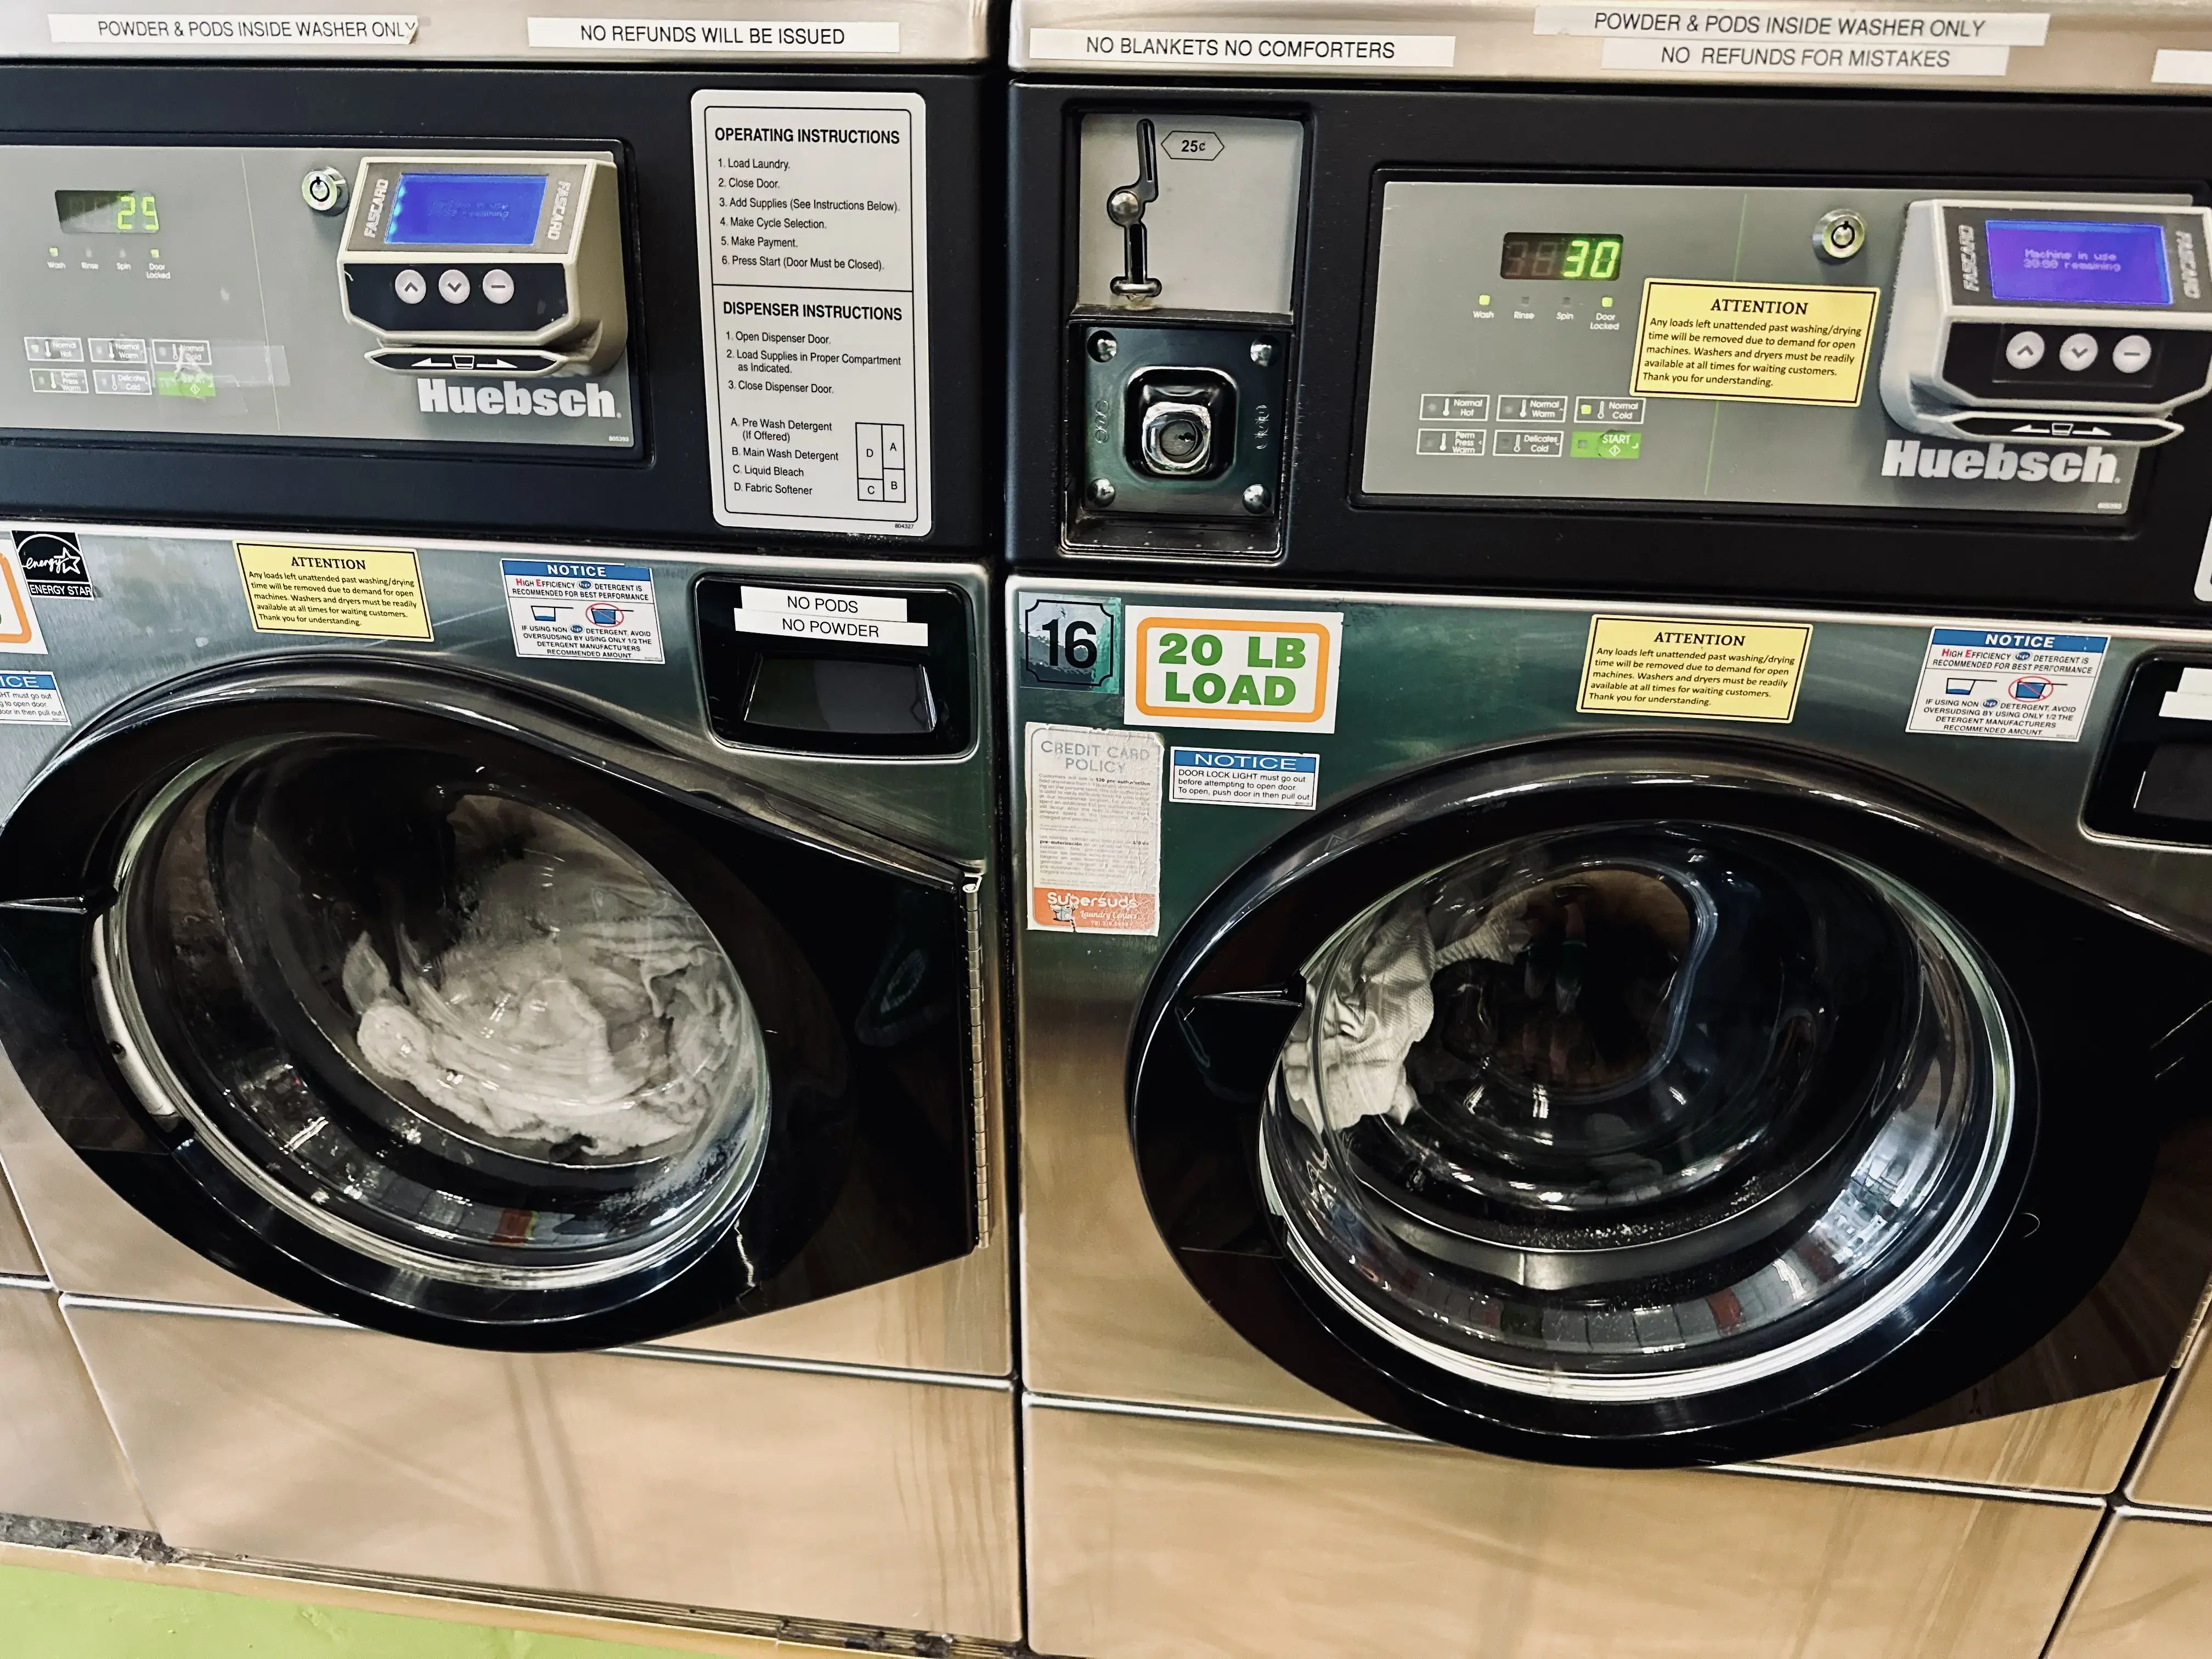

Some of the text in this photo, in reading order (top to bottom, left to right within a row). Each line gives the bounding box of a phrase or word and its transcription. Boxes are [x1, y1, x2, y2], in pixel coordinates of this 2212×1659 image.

[98, 21, 415, 37] POWDER & PODS INSIDE WASHER ONLY
[1595, 13, 1986, 37] POWDER & PODS INSIDE WASHER ONLY
[581, 25, 844, 44] NO REFUNDS WILL BE ISSUED
[1087, 37, 1394, 58] NO BLANKETS NO COMFORTERS
[1662, 47, 1950, 67] NO REFUNDS FOR MISTAKES
[715, 127, 899, 144] OPERATING INSTRUCTIONS
[1182, 140, 1205, 152] 25¢
[718, 158, 790, 171] 1. Load Laundry.
[719, 178, 780, 188] 2. Close Door.
[117, 196, 159, 229] 25
[720, 198, 900, 213] 3. Add Supplies (See Instructions Below).
[720, 217, 827, 229] 4. Make Cycle Selection.
[721, 236, 798, 249] 5. Make Payment.
[722, 256, 884, 272] 6. Press Start (Door Must be Closed).
[1564, 240, 1620, 278] 30
[724, 302, 902, 320] DISPENSER INSTRUCTIONS
[1711, 299, 1808, 314] ATTENTION
[1556, 312, 1573, 320] Spin
[1596, 313, 1615, 321] Door
[1650, 318, 1861, 337] Any loads left unattended past washing/drying
[1649, 331, 1668, 340] time
[1672, 332, 1686, 341] will
[1689, 333, 1700, 341] be
[1703, 335, 1743, 343] removed
[1746, 336, 1763, 345] due
[1778, 337, 1815, 347] demand
[1818, 339, 1831, 347] for
[1647, 346, 1691, 354] machines.
[1694, 347, 1732, 357] Washers
[1735, 349, 1752, 358] and
[1754, 350, 1782, 360] dryers
[1810, 353, 1821, 361] be
[1824, 354, 1854, 364] readily
[1645, 359, 1683, 368] available
[1697, 361, 1707, 369] all
[1710, 362, 1735, 370] times
[1737, 363, 1751, 371] for
[1753, 365, 1786, 375] waiting
[1788, 367, 1837, 375] customers.
[1643, 373, 1669, 381] Thank
[1691, 374, 1704, 382] for
[1706, 376, 1773, 387] understanding.
[417, 379, 615, 418] Huebsch
[1602, 435, 1630, 444] START
[1882, 439, 2115, 483] Huebsch
[291, 557, 365, 569] ATTENTION
[548, 565, 606, 577] NOTICE
[30, 584, 92, 596] ENERGY STAR
[788, 596, 857, 613] NO PODS
[783, 618, 878, 637] NO POWDER
[1042, 618, 1097, 669] 16
[1654, 632, 1746, 646] ATTENTION
[1985, 634, 2055, 648] NOTICE
[1159, 633, 1306, 669] 20 LB
[1933, 659, 1992, 668] RECOMMENDED
[2034, 665, 2092, 674] PERFORMANCE
[1165, 672, 1296, 706] LOAD
[1041, 741, 1149, 760] CREDIT CARD
[1066, 757, 1125, 774] POLICY
[1195, 754, 1296, 770] NOTICE
[1047, 892, 1137, 909] Supersuds
